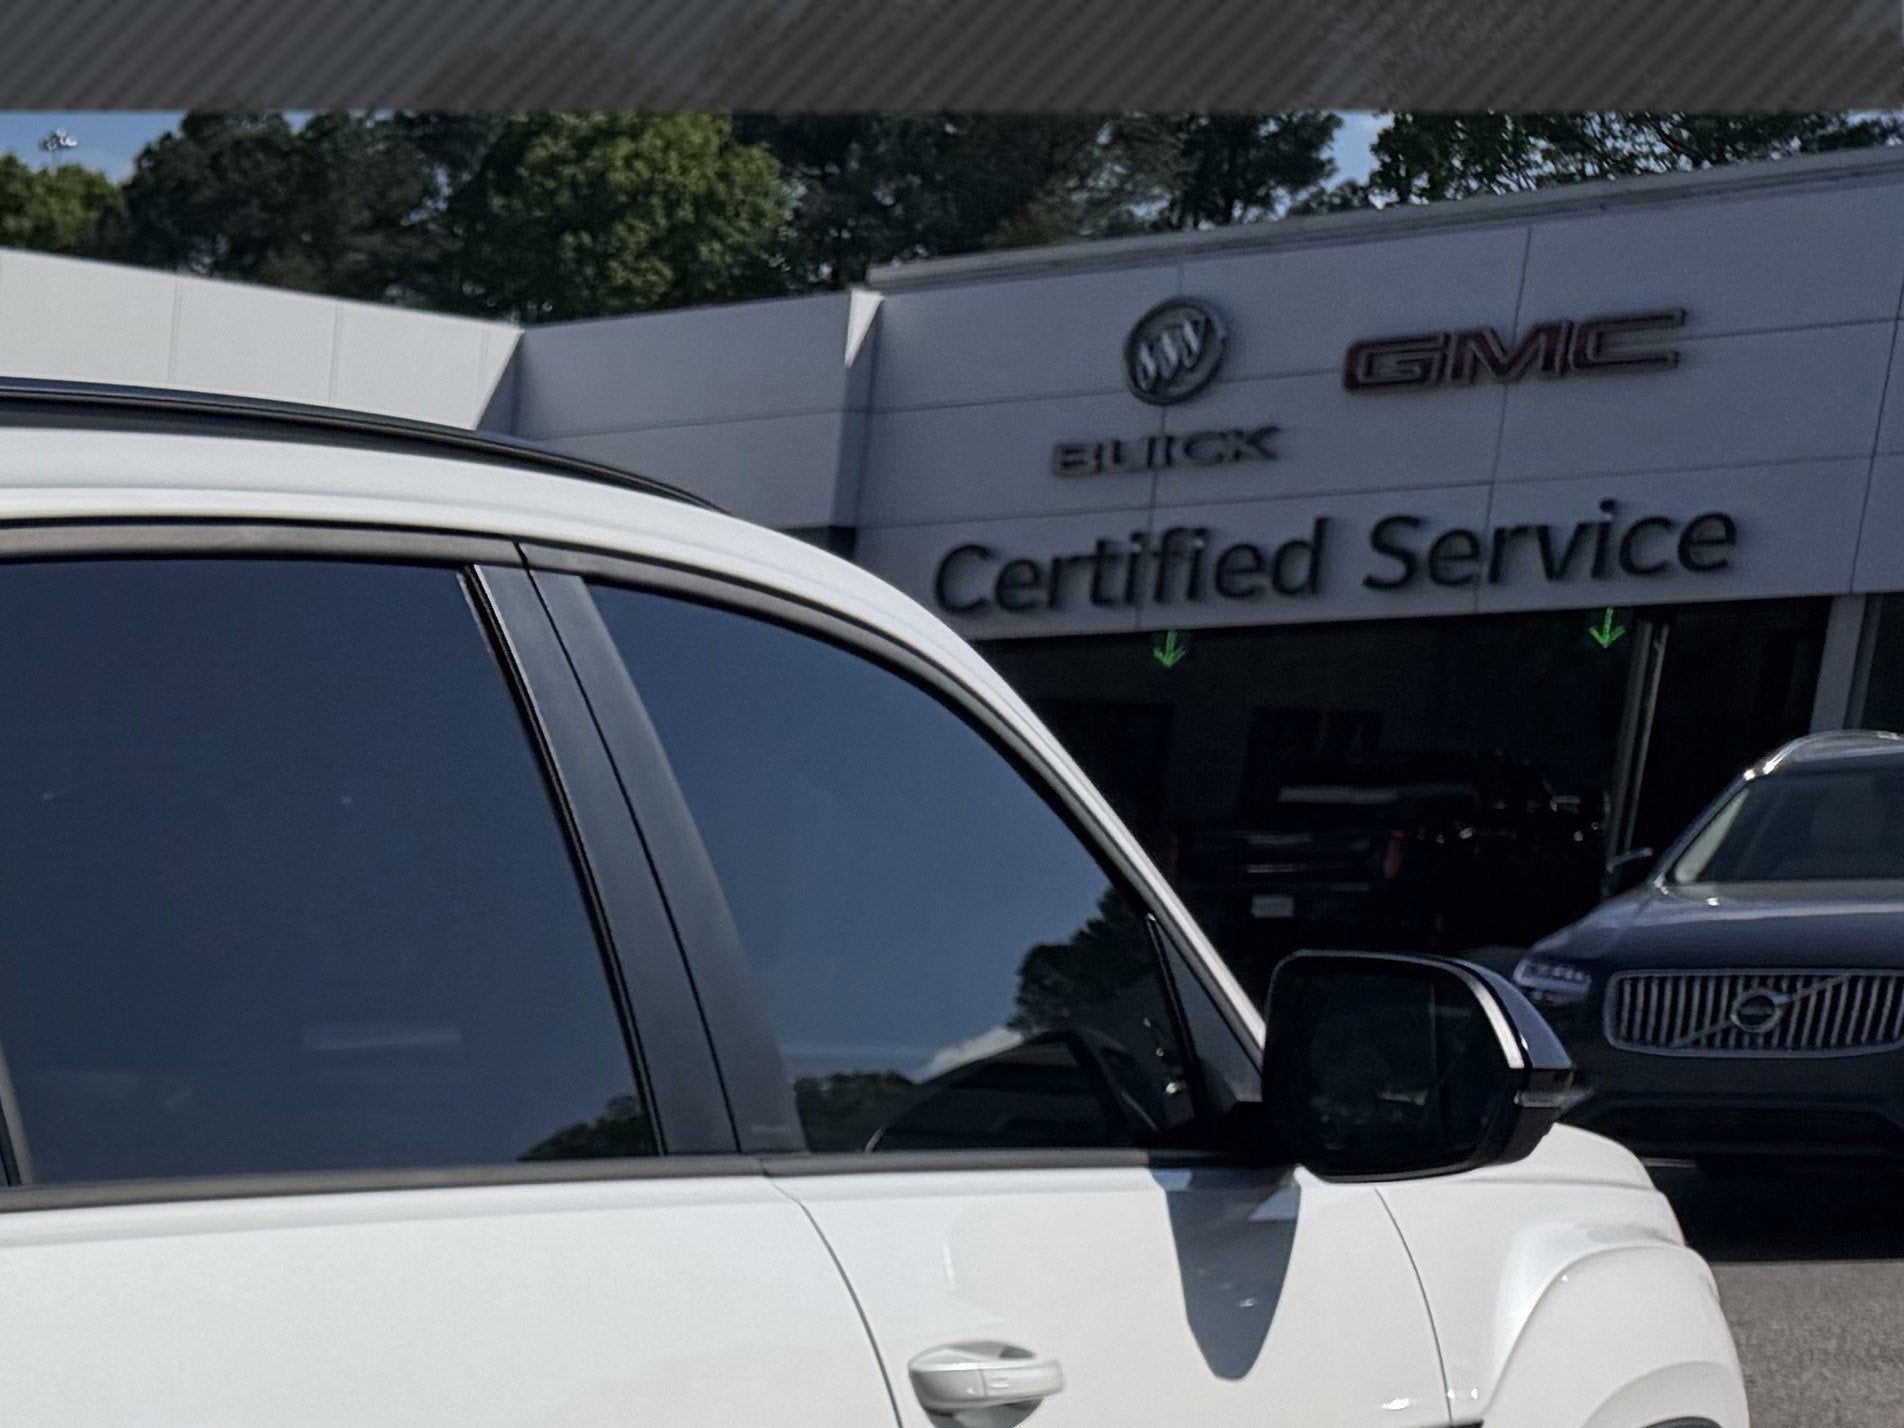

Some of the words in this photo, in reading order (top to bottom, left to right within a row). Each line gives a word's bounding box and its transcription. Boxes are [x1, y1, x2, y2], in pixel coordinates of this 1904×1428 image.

[1343, 308, 1686, 392] GMC
[1053, 425, 1279, 478] BUICK
[934, 516, 1330, 614] Certified
[1362, 497, 1738, 591] Service
